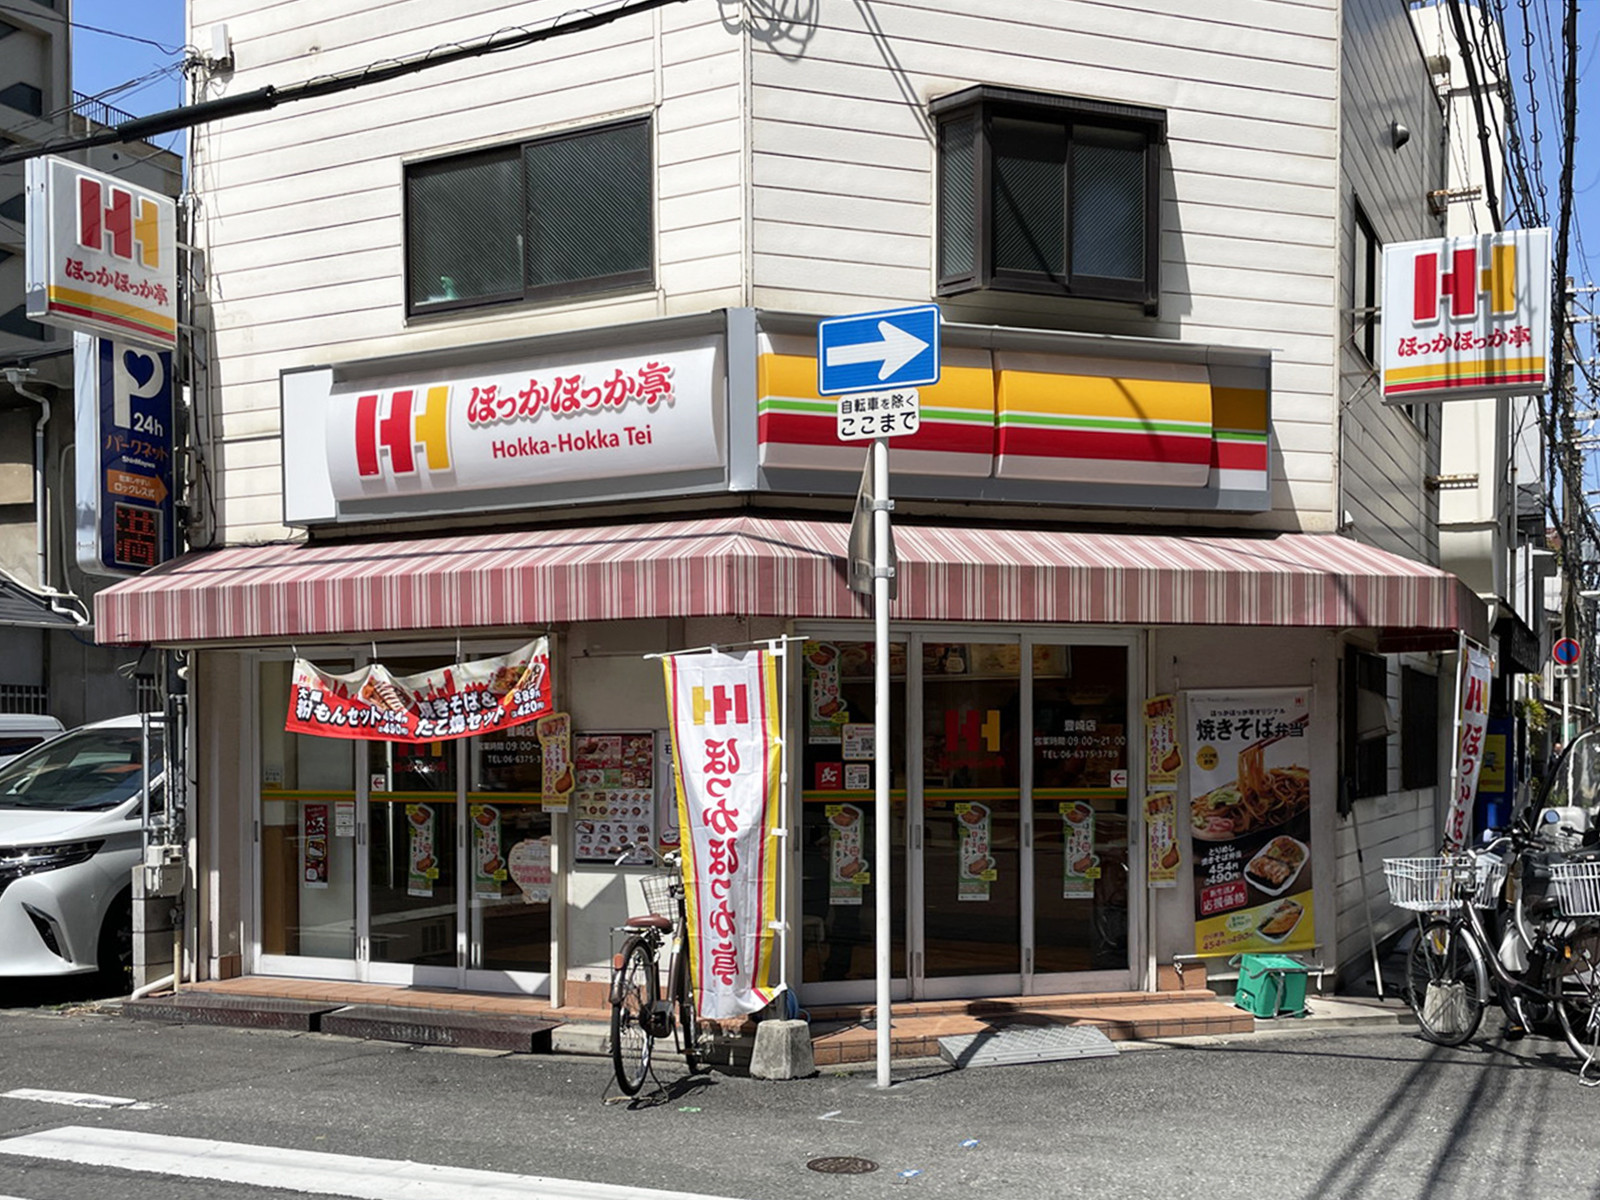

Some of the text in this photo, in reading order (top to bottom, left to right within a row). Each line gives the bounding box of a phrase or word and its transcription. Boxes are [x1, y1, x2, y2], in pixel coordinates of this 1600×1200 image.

[65, 257, 168, 306] ほっかほっか亭
[1398, 325, 1531, 357] ほっかほっか亭
[467, 361, 674, 425] ほっかほっか亭
[841, 393, 915, 414] 自転車を除く
[133, 412, 163, 437] 24h
[841, 411, 916, 436] ここまで
[105, 434, 169, 460] パークネット
[492, 425, 652, 459] Hokka-Hokka Tei
[296, 700, 381, 726] 粉もんセット
[414, 704, 504, 736] たこ焼セット
[1196, 716, 1305, 741] 焼きそば弁当
[1208, 861, 1239, 873] 454円
